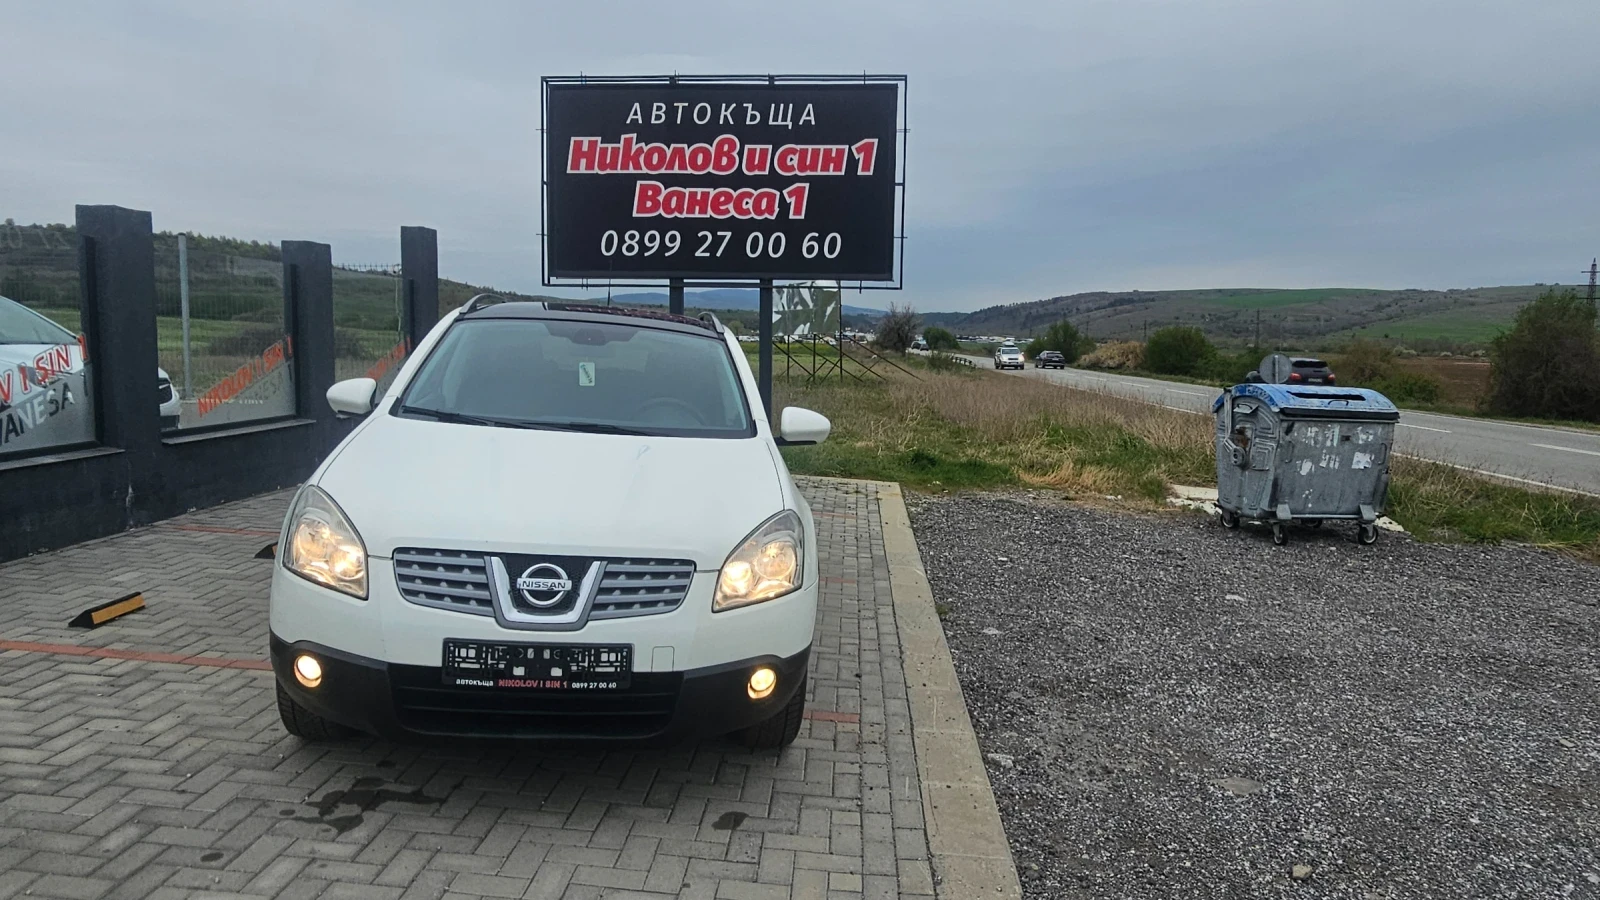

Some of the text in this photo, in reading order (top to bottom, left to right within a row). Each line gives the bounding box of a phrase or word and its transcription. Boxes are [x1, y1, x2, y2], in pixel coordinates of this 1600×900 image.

[626, 102, 816, 129] АВТОКЪЩА
[566, 133, 878, 176] Николов и син 1
[632, 180, 809, 219] Ванеса 1
[600, 230, 842, 259] 0899 27 00 60
[34, 343, 72, 386] SIN
[522, 580, 566, 589] NISSAN
[455, 678, 494, 687] автокъща
[498, 679, 539, 688] NIKOLOV
